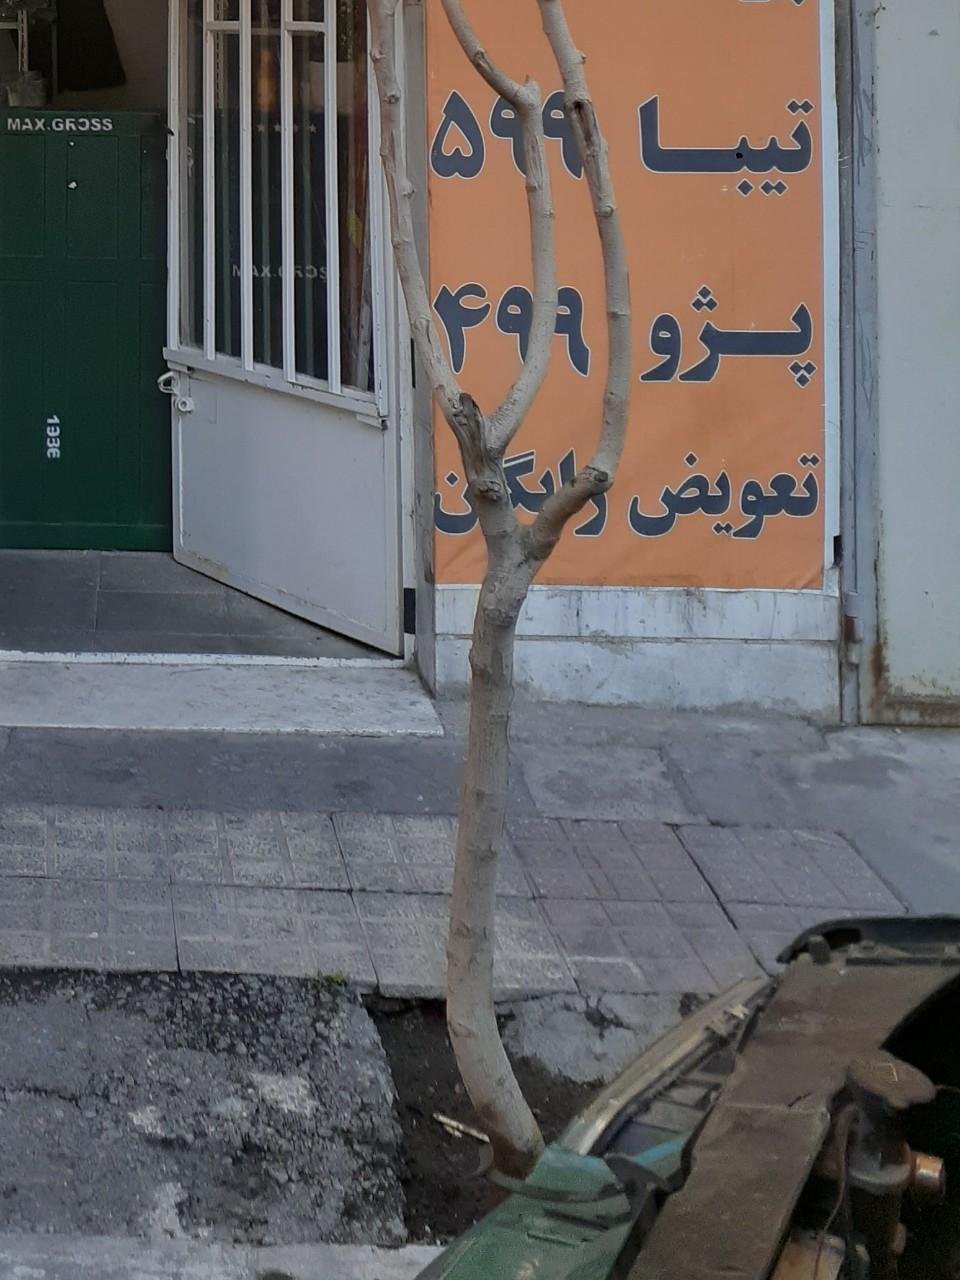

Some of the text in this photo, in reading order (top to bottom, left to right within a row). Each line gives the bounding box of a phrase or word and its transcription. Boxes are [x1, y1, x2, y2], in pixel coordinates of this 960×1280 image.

[637, 94, 814, 196] تیبا
[640, 285, 817, 388] پژو
[628, 450, 820, 540] تعویض
